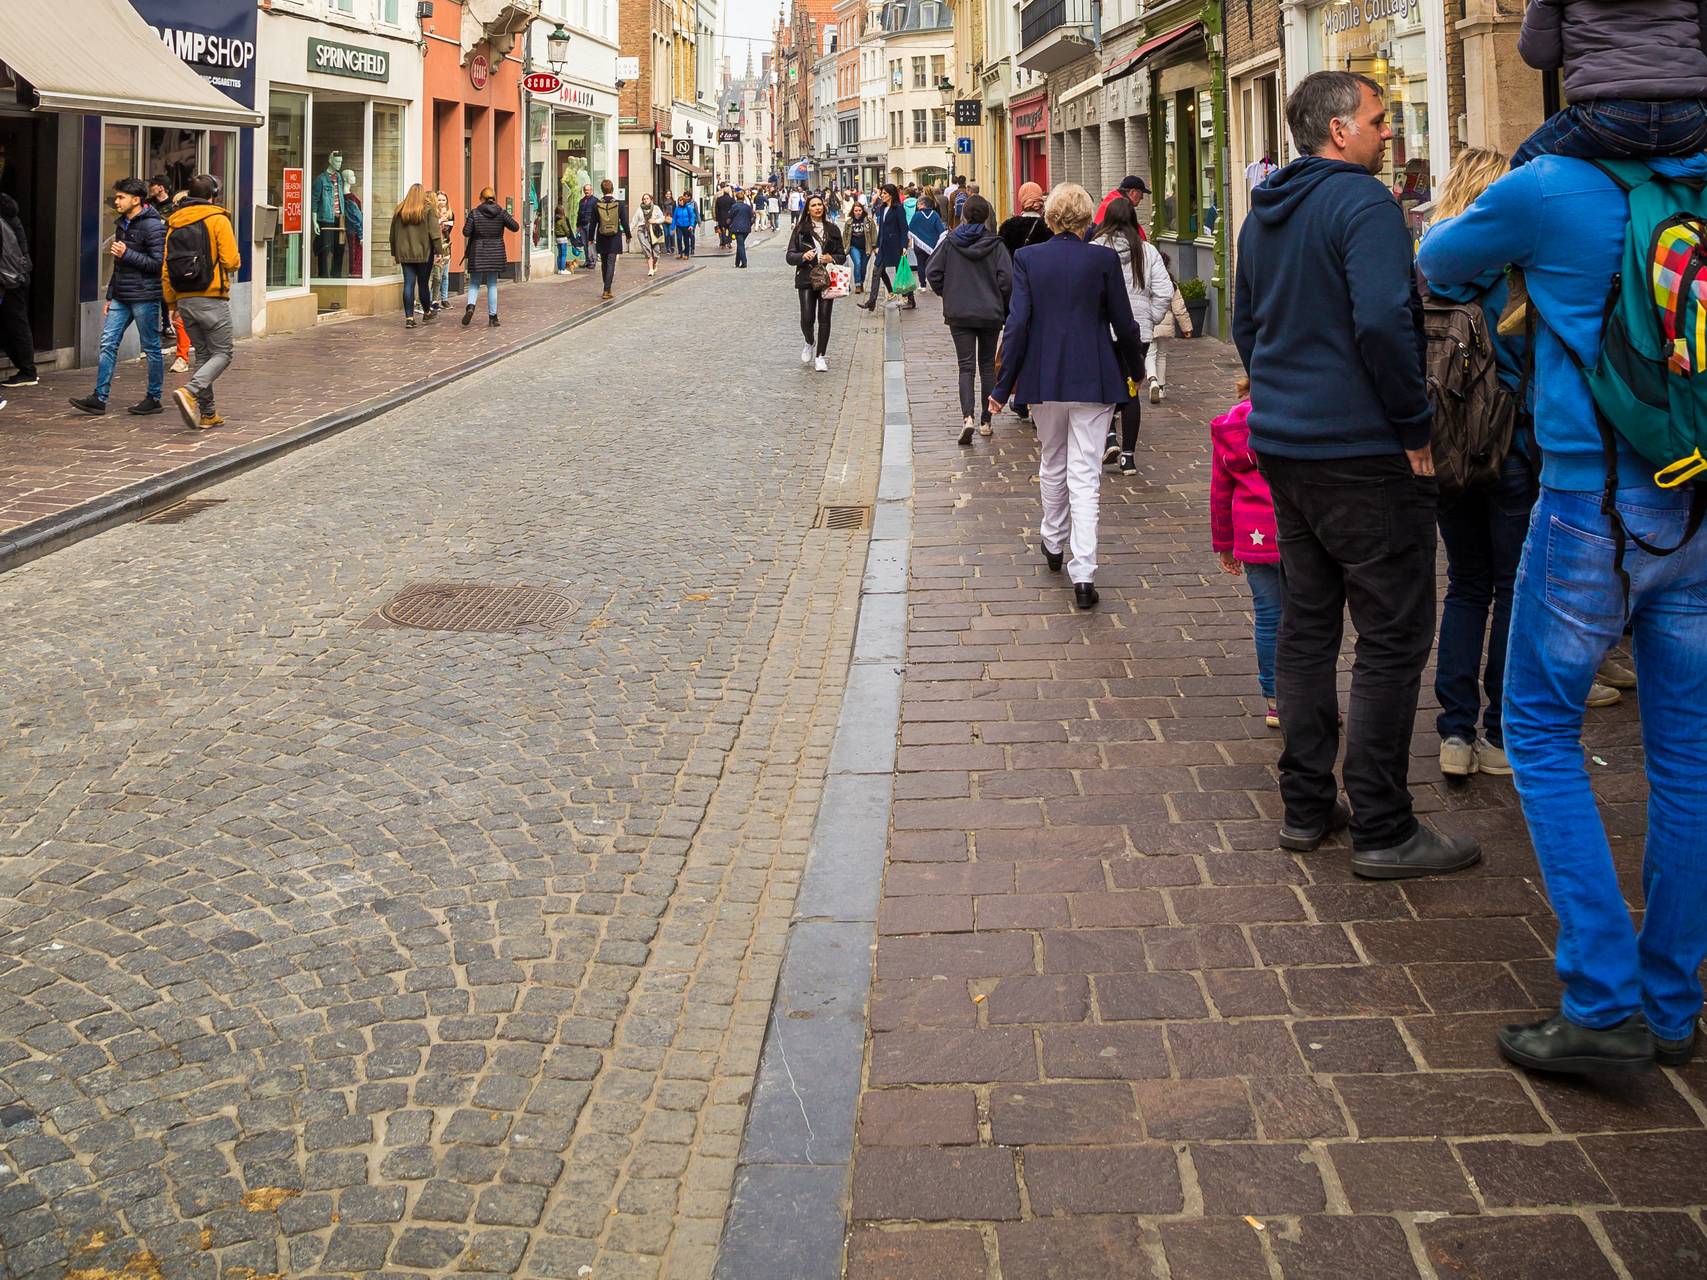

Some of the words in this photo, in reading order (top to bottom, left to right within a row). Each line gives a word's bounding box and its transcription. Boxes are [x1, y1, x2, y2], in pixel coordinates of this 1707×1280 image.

[1323, 1, 1360, 37] Mobile
[316, 44, 386, 75] SPRINGFIELD
[527, 78, 556, 88] SCORE
[285, 203, 302, 216] -50%
